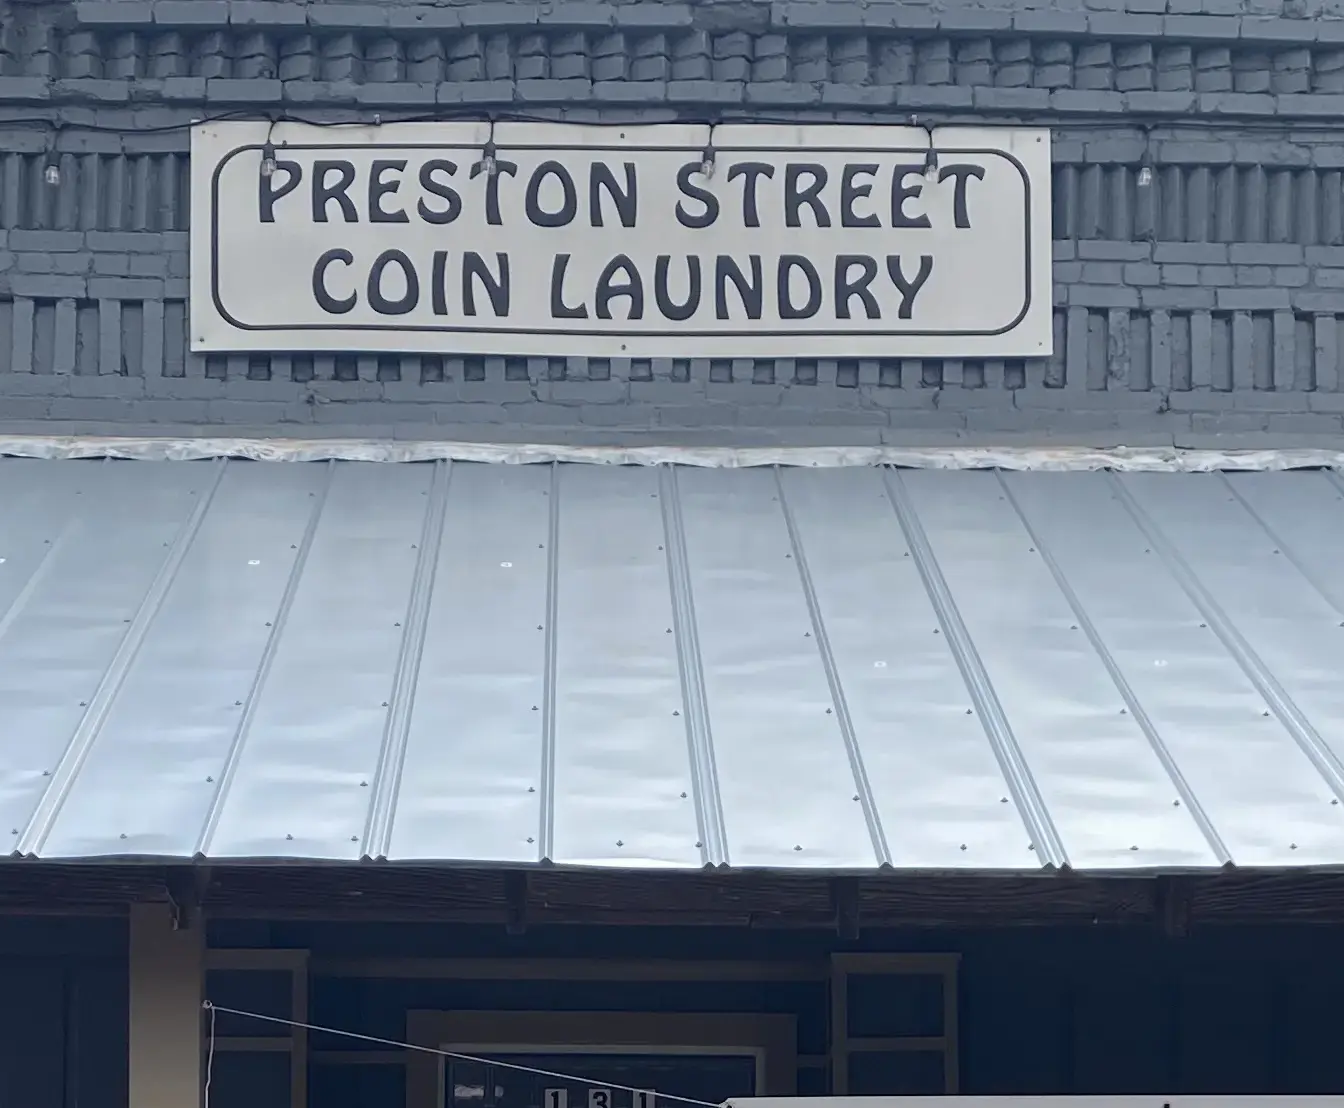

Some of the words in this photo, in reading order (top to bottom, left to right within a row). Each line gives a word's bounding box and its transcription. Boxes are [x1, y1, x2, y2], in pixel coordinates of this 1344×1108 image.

[259, 158, 638, 229] PRESTON
[675, 160, 987, 230] STREET
[311, 248, 510, 317] COIN
[550, 252, 935, 321] LAUNDRY
